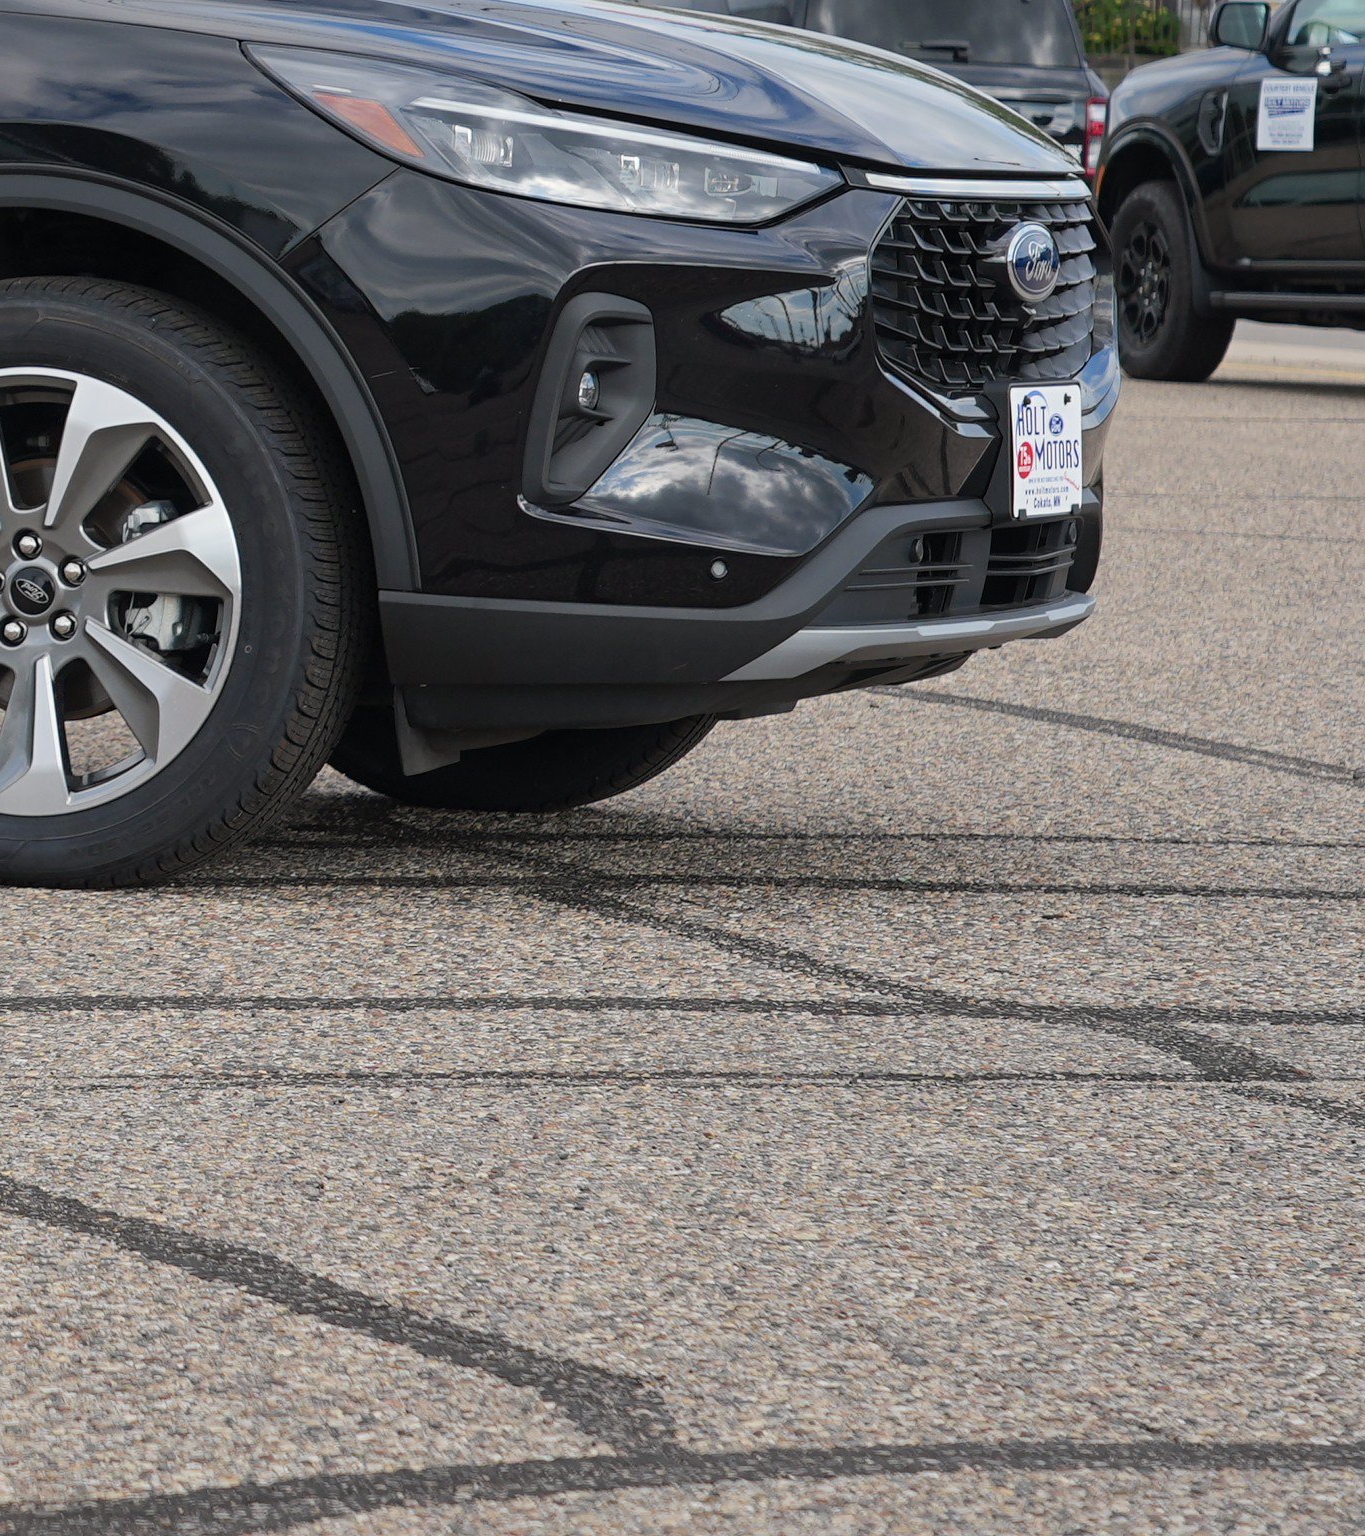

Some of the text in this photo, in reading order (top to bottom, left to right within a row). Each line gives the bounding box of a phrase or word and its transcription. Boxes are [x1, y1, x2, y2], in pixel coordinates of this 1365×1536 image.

[1025, 241, 1051, 282] Ford
[1017, 404, 1047, 437] HOLT
[1035, 438, 1080, 471] MOTORS
